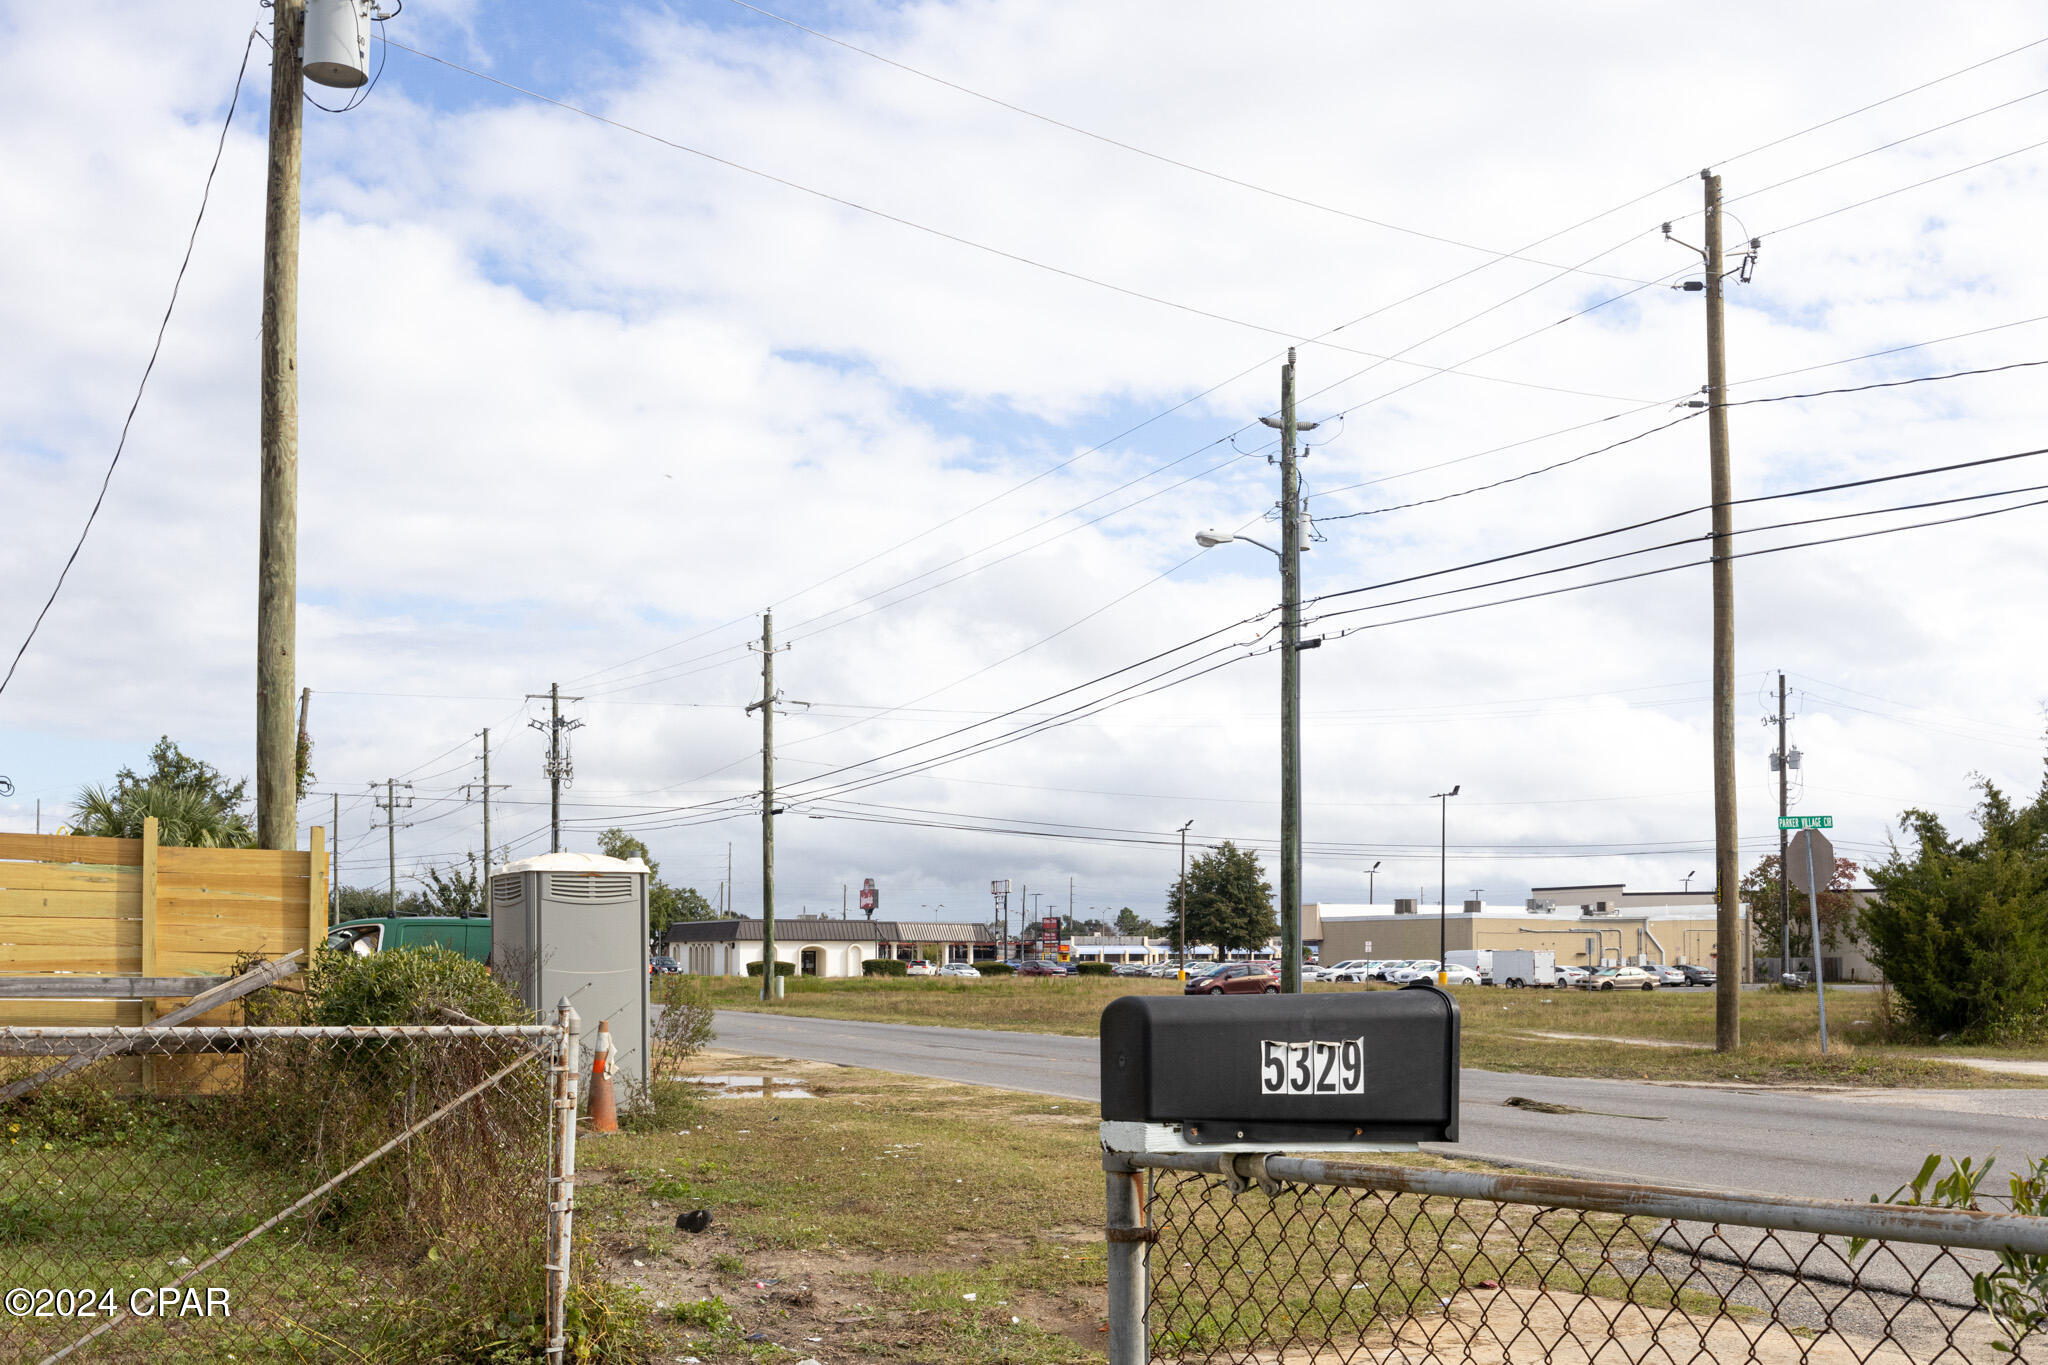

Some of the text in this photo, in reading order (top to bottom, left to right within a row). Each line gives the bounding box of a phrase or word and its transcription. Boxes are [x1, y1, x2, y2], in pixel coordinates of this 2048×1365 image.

[1779, 818, 1799, 828] PARKER
[1801, 817, 1821, 828] VILLAGE
[1264, 1040, 1361, 1092] 5329
